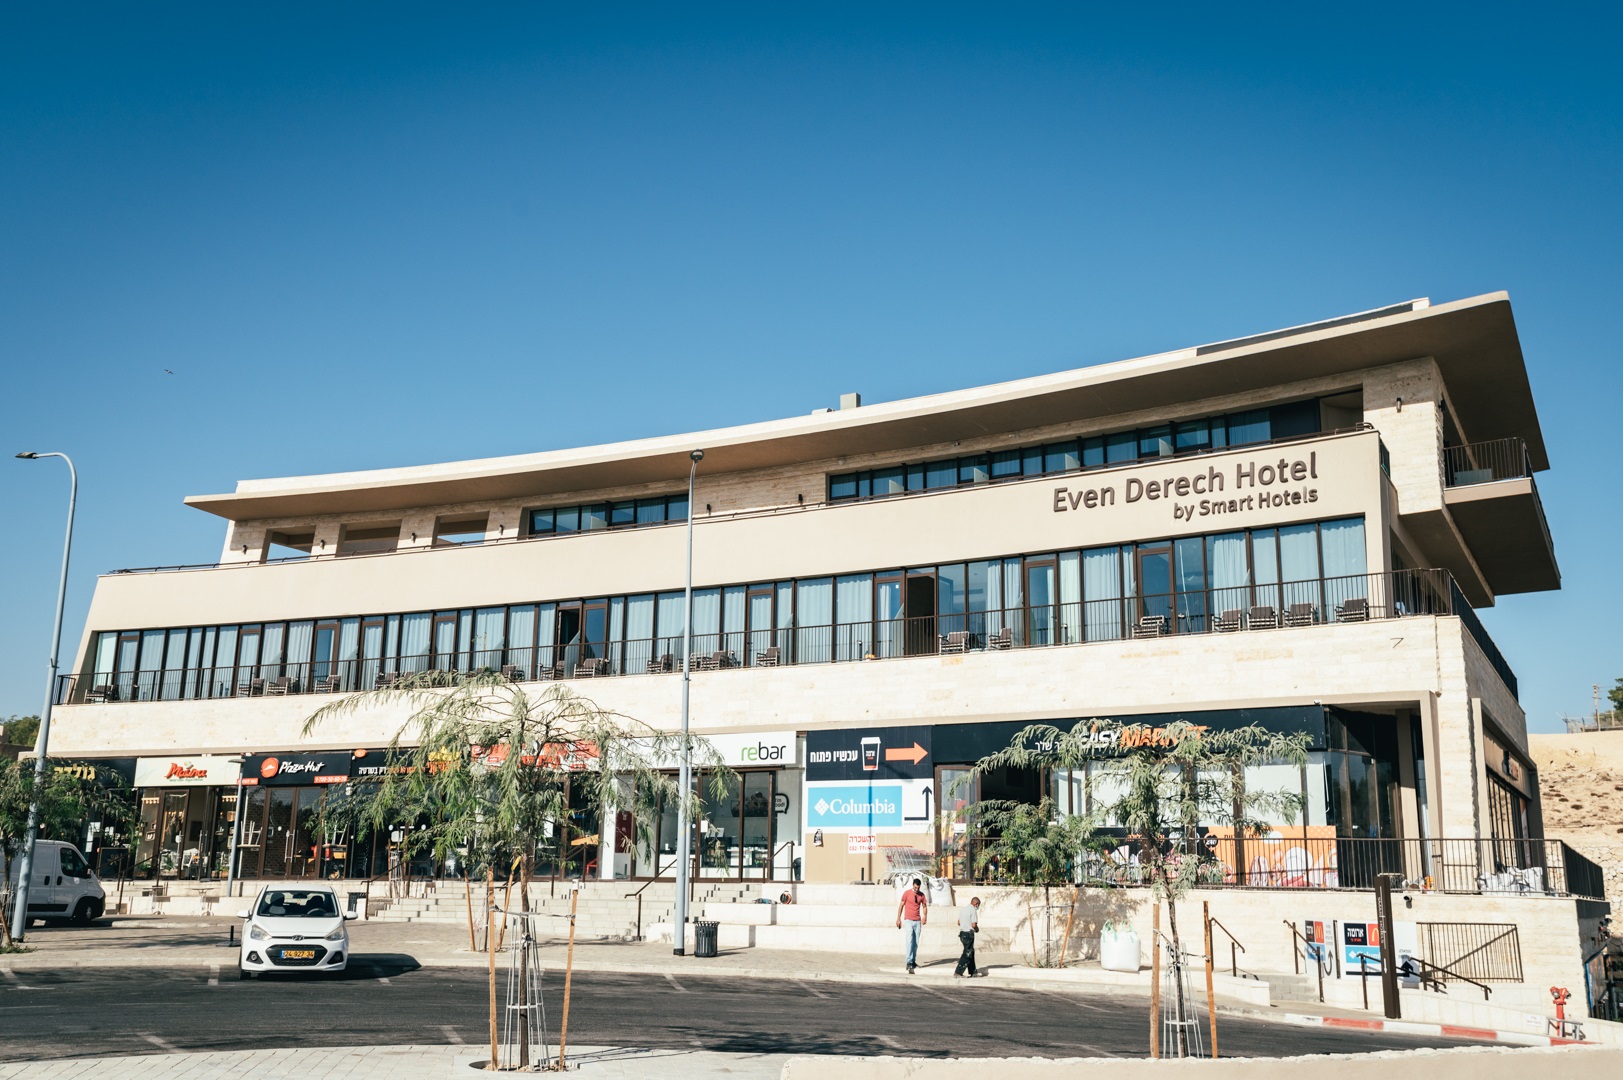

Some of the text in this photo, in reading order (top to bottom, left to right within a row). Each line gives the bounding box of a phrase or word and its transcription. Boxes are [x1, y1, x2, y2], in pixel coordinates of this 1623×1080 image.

[1053, 451, 1318, 512] Even Derech Hotel
[1173, 486, 1318, 522] by Smart Hotels
[1119, 725, 1209, 748] MART
[741, 741, 787, 761] rebar
[810, 750, 858, 763] עכשיו פתוח
[279, 760, 325, 775] Pizza Hut
[829, 798, 896, 815] Columbia
[848, 835, 876, 843] להשכרה
